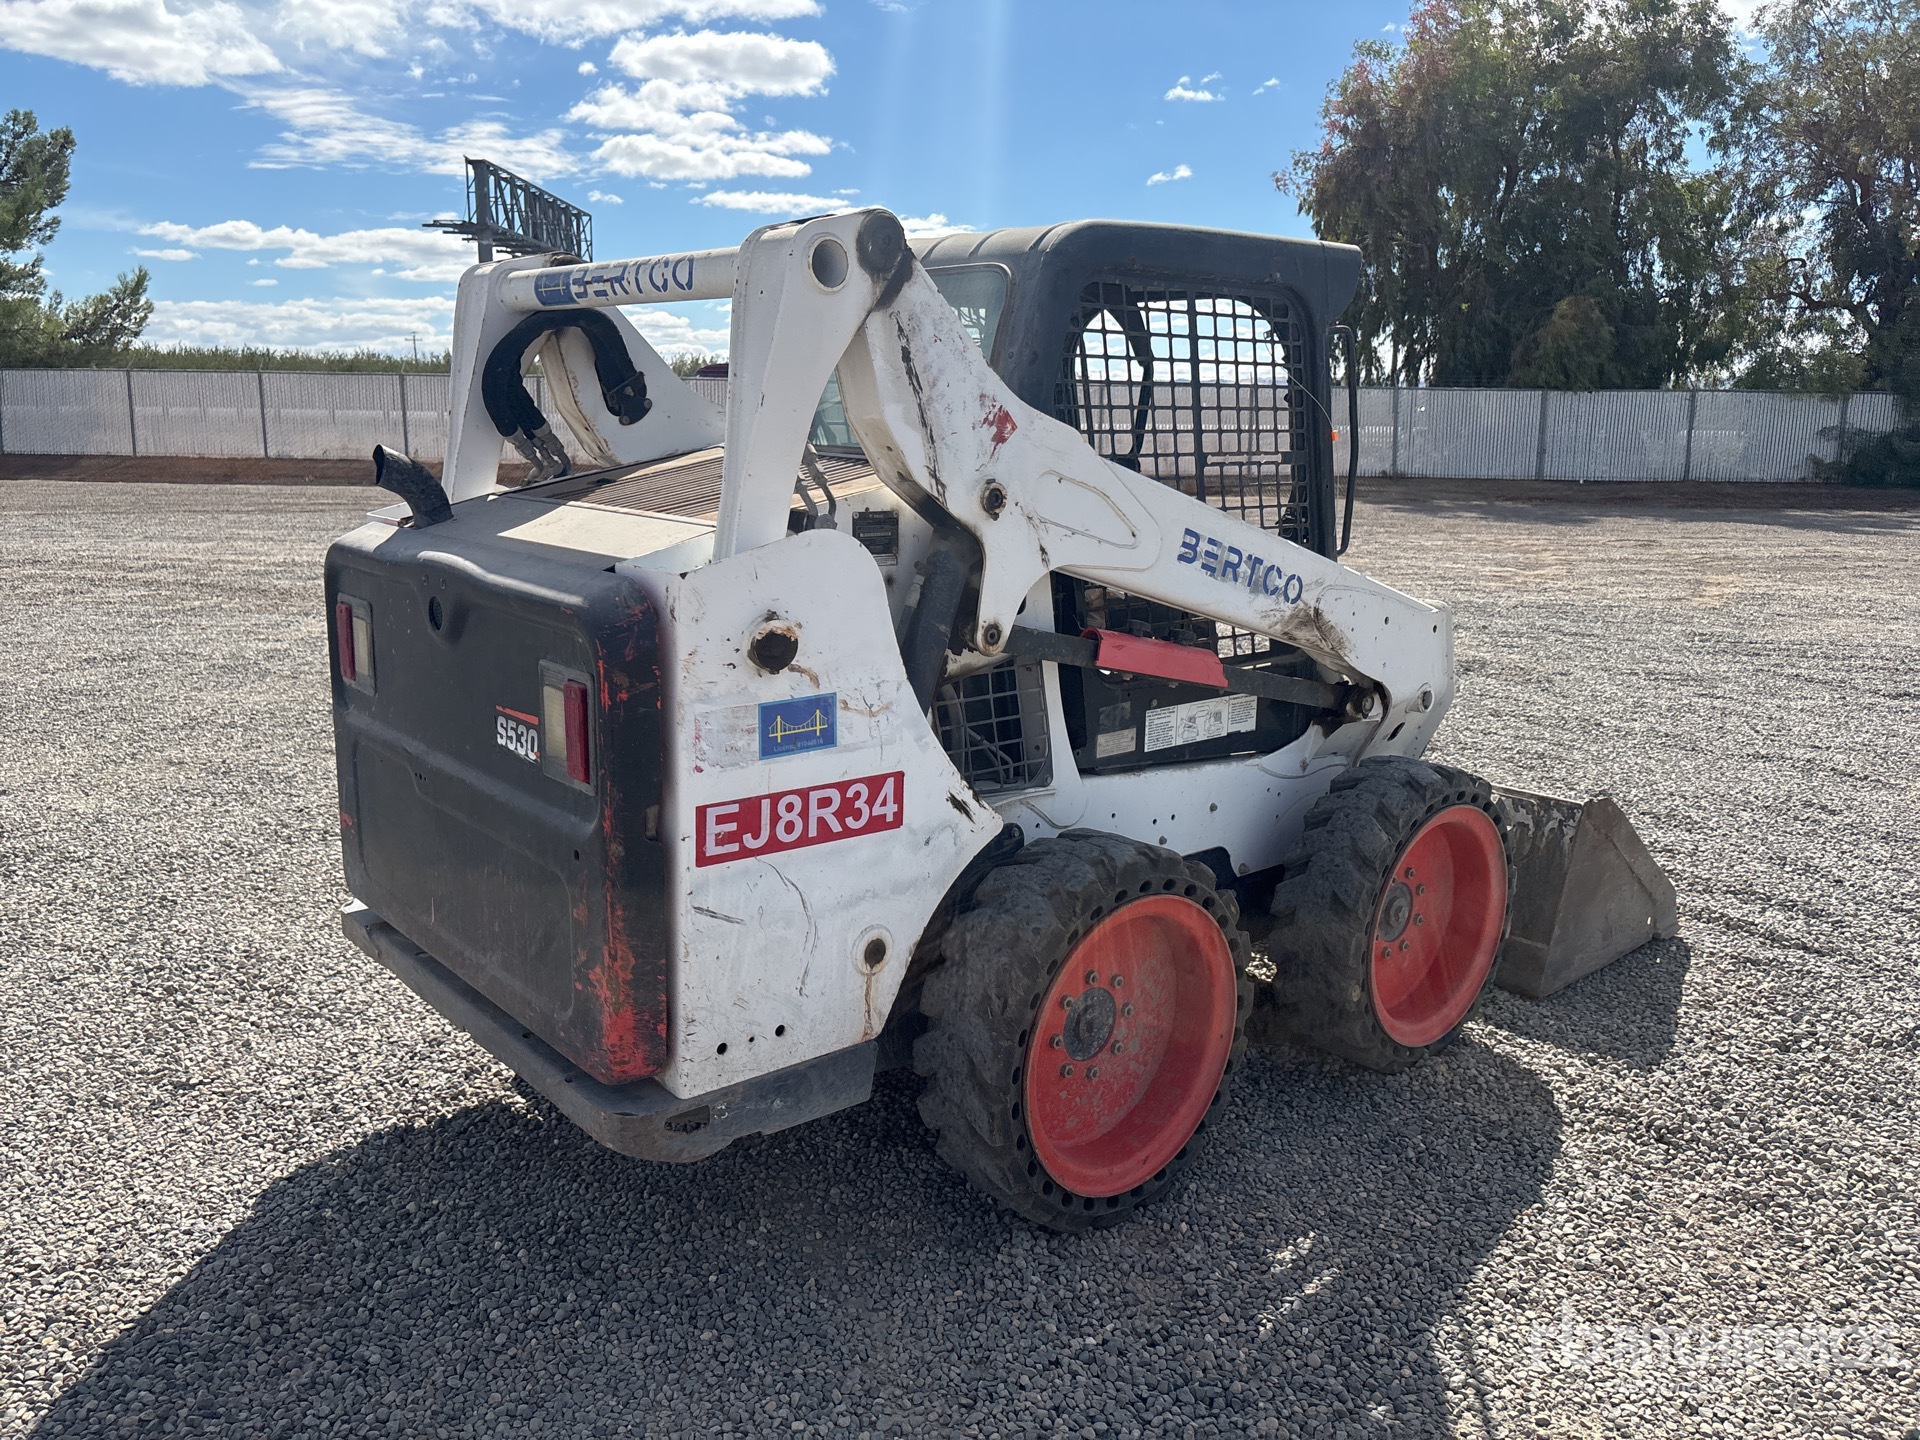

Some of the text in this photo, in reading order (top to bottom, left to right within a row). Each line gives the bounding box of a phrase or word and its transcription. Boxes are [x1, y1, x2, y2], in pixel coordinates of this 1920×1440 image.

[571, 254, 695, 299] BERTCO
[1177, 527, 1304, 605] BERTCO
[496, 715, 538, 760] S530
[705, 776, 898, 857] EJ8R34
